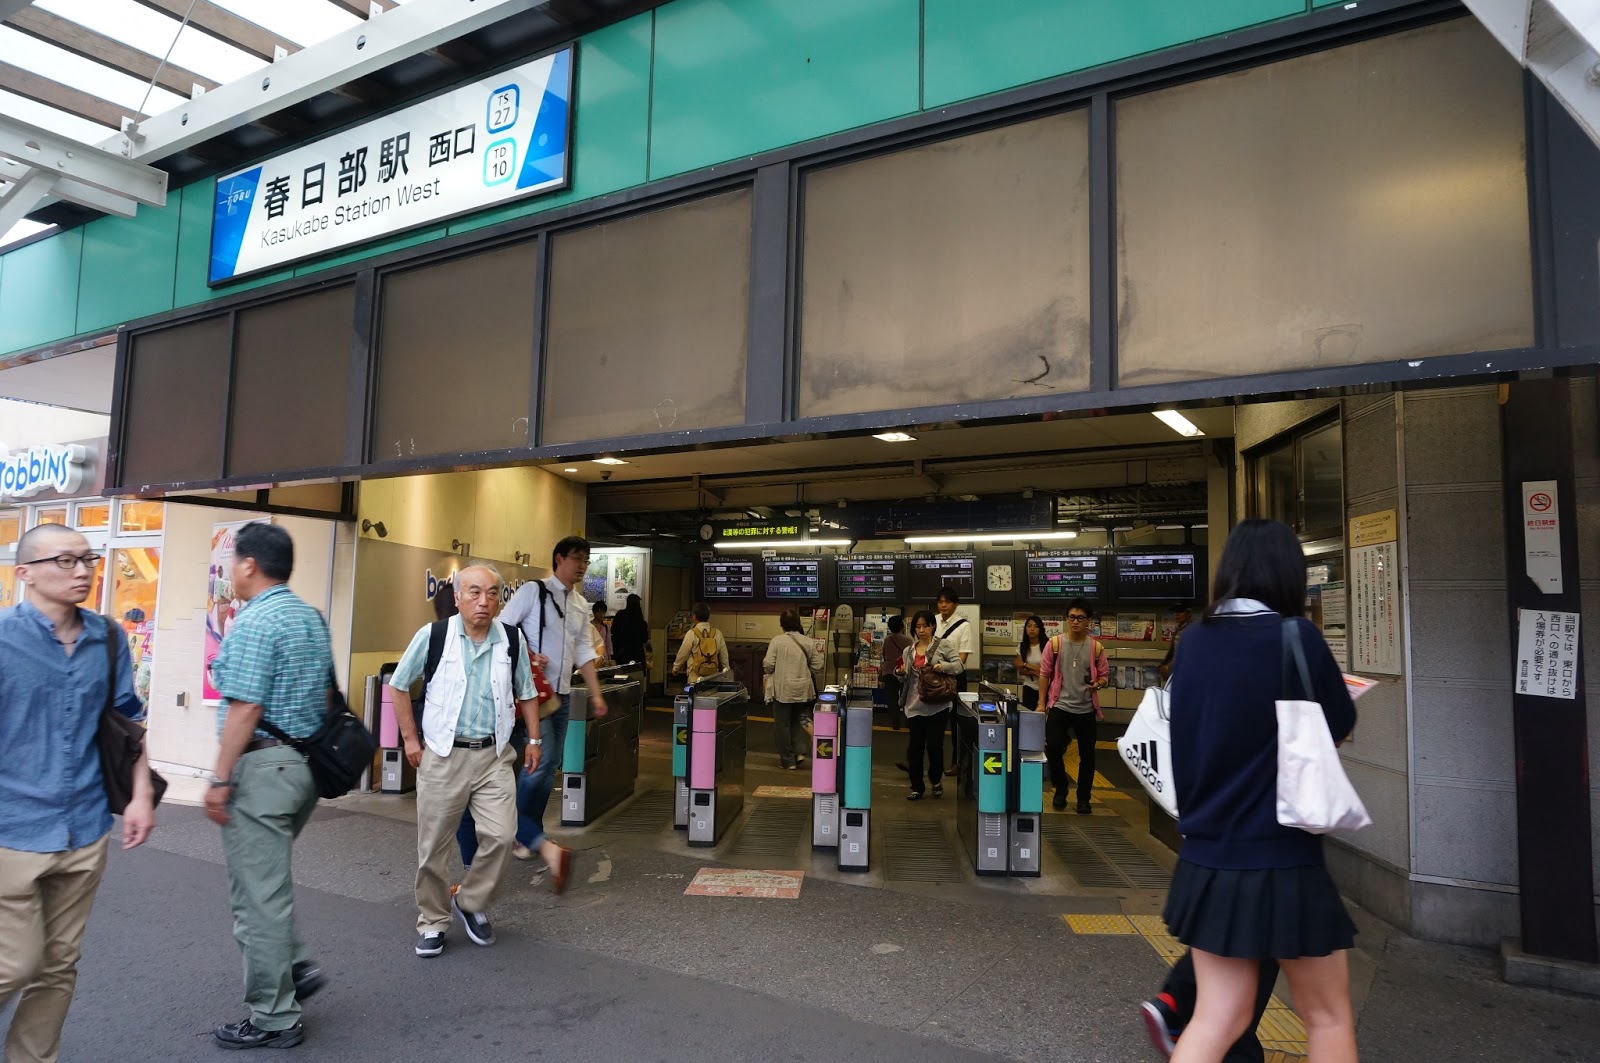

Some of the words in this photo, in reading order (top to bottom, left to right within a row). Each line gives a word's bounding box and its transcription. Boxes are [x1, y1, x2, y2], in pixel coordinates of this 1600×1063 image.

[497, 93, 509, 106] TS
[494, 108, 510, 126] 27
[493, 147, 508, 160] TD
[264, 131, 411, 221] 春日部駅
[428, 123, 476, 168] 西口
[492, 161, 507, 179] 10
[260, 212, 329, 248] Kasukabe
[334, 192, 391, 226] Station
[396, 178, 441, 207] West
[1548, 613, 1560, 695] 西口への通り抜けは
[1126, 748, 1163, 793] adidas
